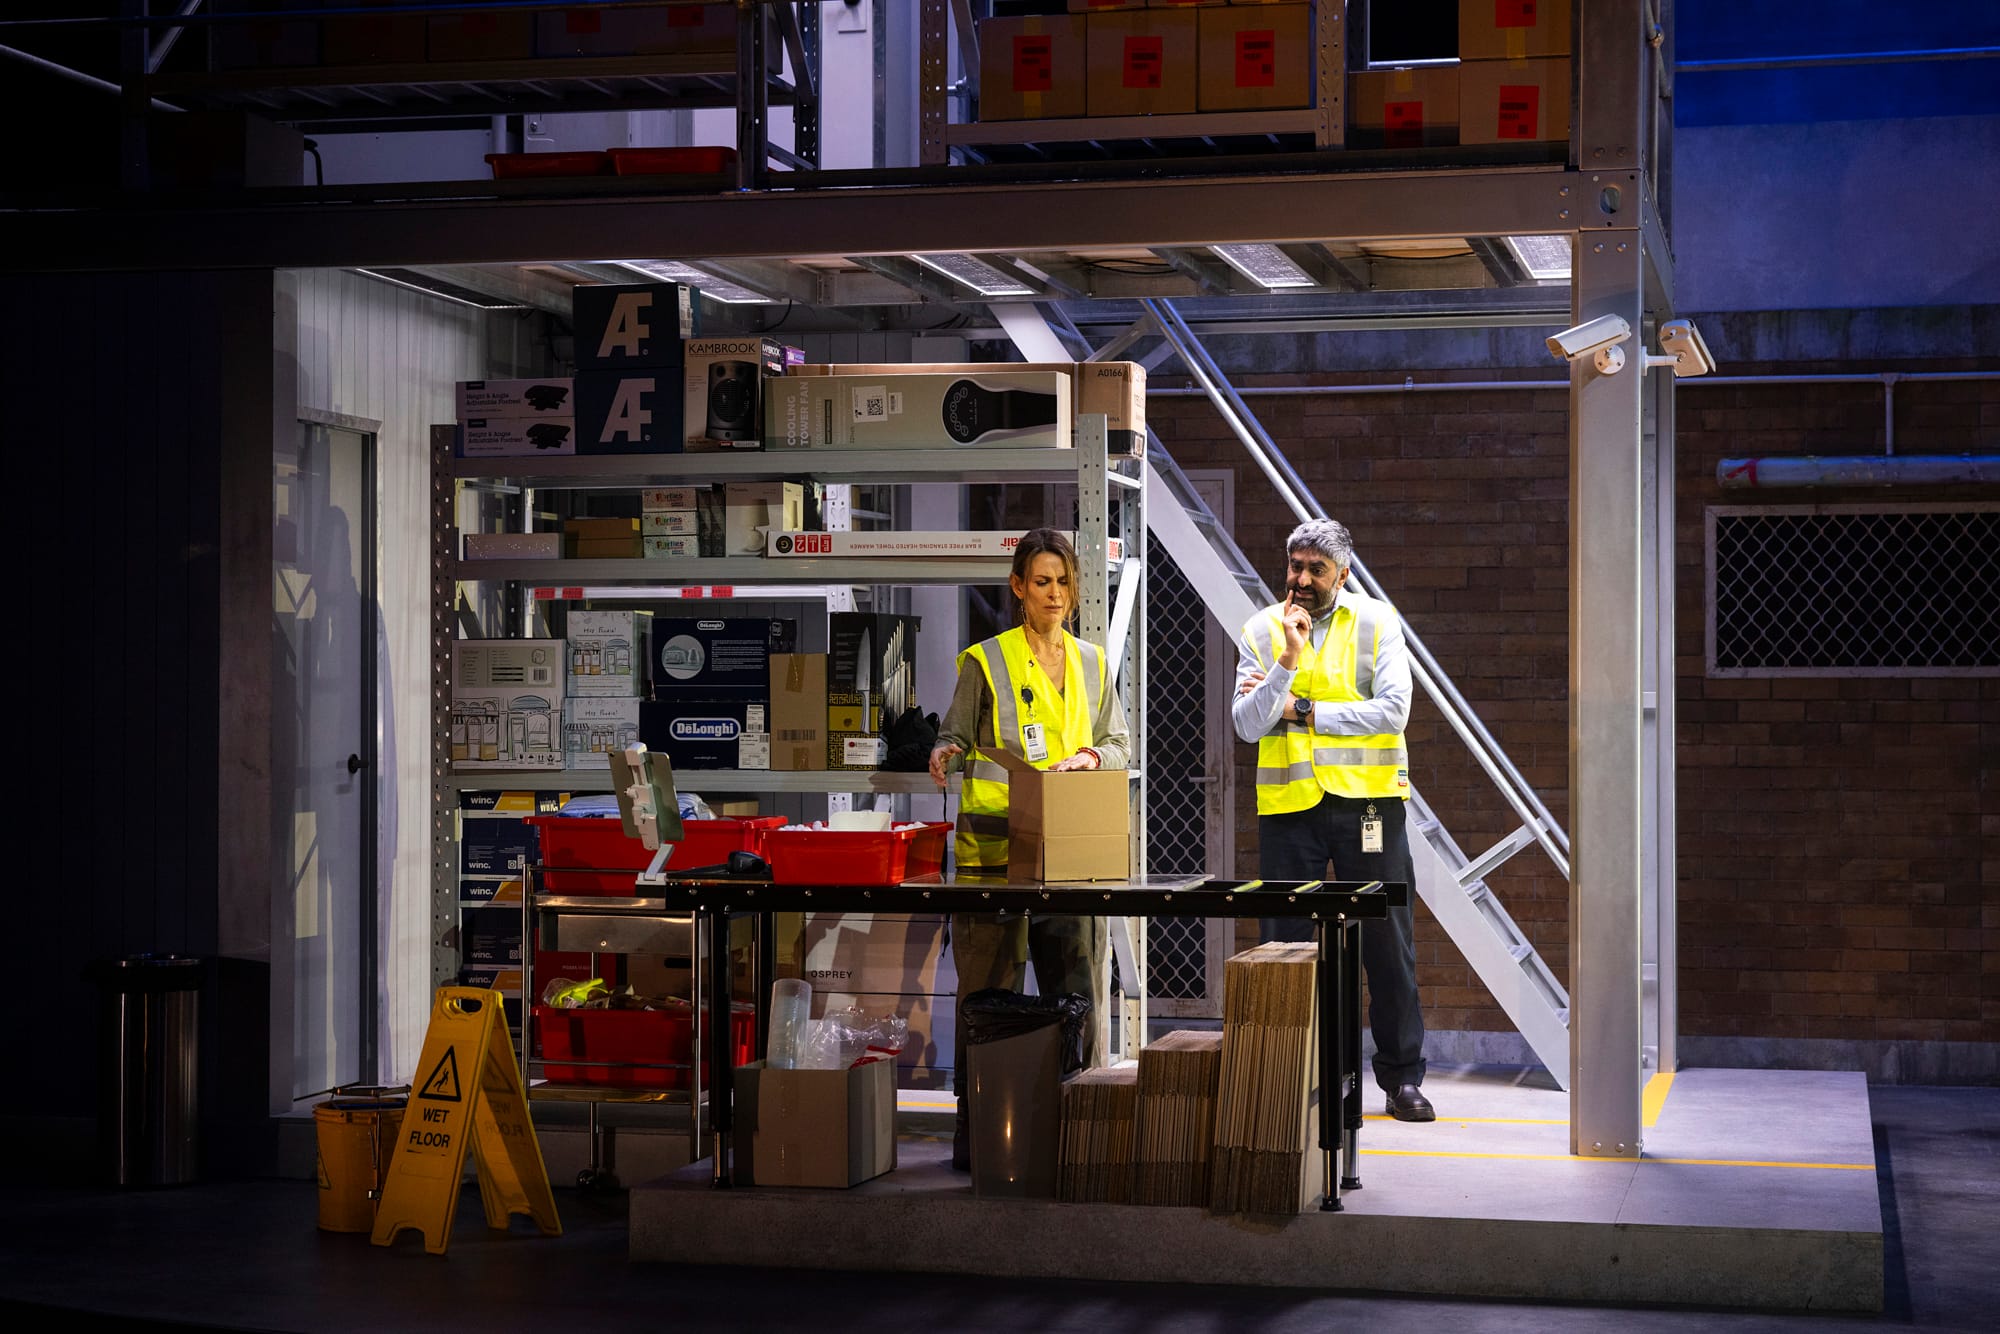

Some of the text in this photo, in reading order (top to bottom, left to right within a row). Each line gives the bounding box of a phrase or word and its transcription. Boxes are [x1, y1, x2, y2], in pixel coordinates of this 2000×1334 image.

[688, 343, 756, 354] KAMBROOK
[800, 381, 809, 446] TOWER FAN
[786, 394, 796, 446] COOLING
[470, 796, 494, 805] winc.
[468, 860, 491, 870] winc.
[470, 887, 493, 896] winc.
[470, 950, 493, 959] winc.
[468, 975, 491, 984] winc.
[810, 970, 852, 979] OSPREY
[423, 1108, 450, 1123] WET
[409, 1130, 450, 1148] FLOOR
